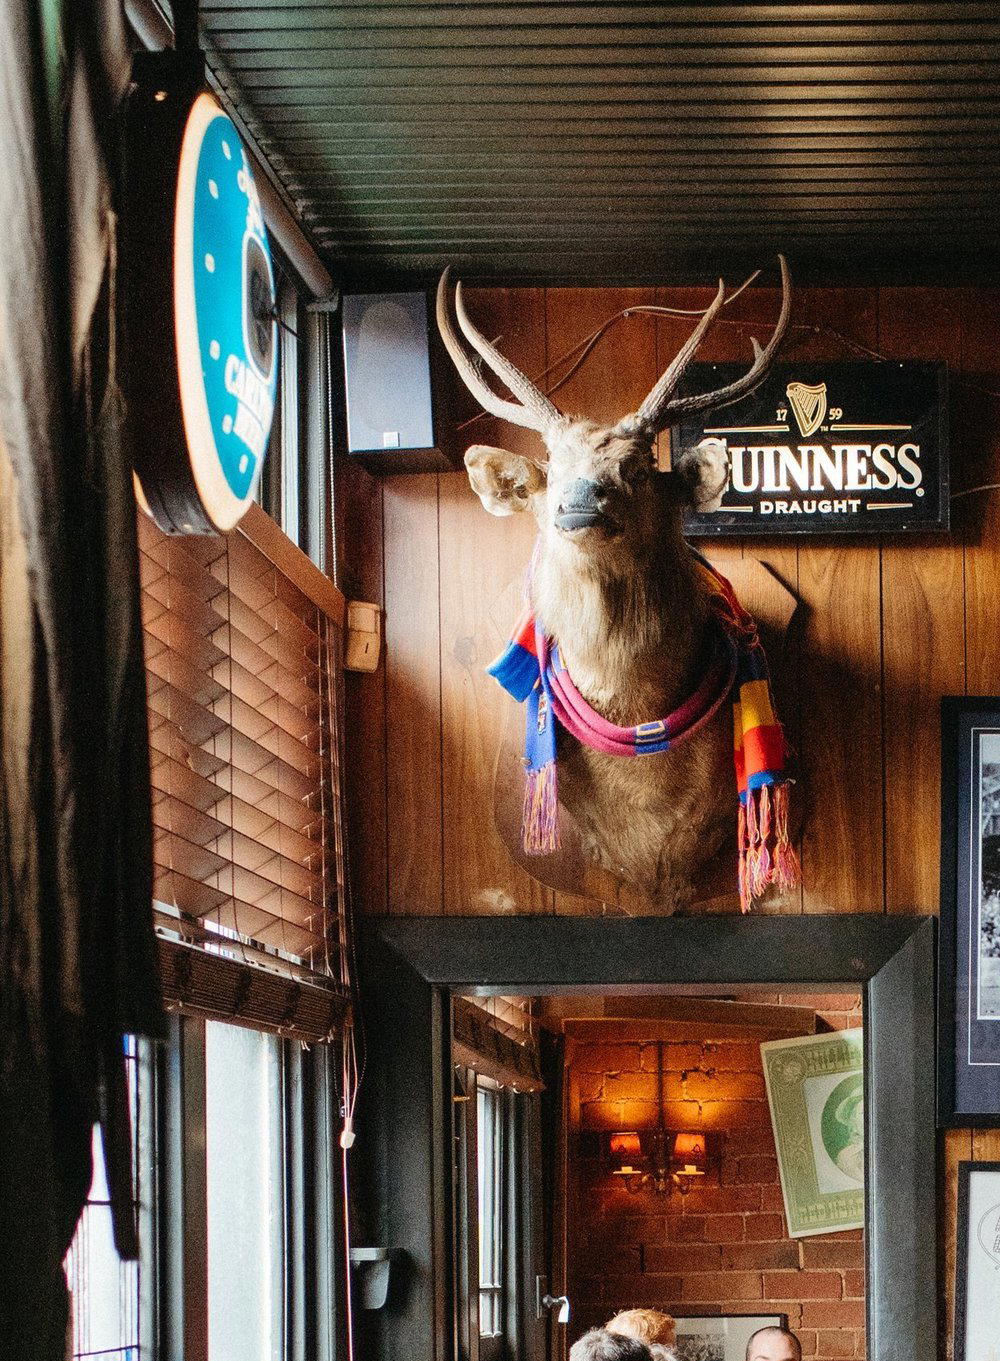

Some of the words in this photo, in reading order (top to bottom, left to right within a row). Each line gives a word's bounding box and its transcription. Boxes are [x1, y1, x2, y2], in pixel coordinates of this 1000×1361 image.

[776, 409, 788, 421] 17
[829, 408, 842, 421] 59
[760, 499, 861, 514] DRAUGHT
